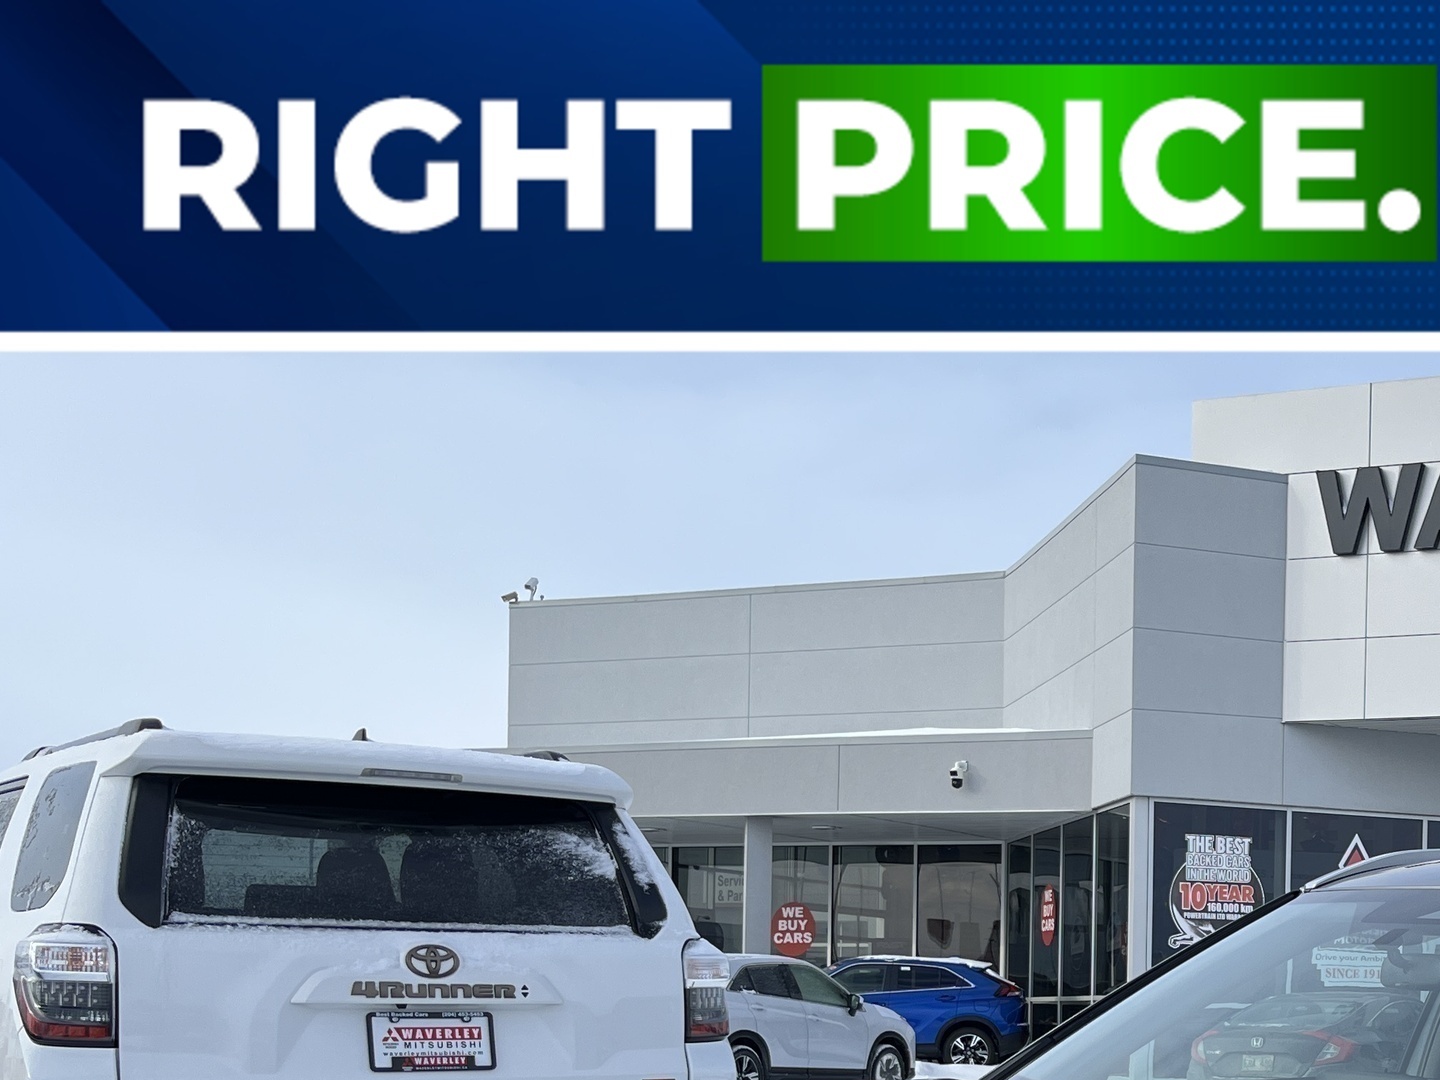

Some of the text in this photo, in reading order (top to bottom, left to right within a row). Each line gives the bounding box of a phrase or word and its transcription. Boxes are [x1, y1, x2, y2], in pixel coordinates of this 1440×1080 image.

[1186, 835, 1252, 855] THE BEST
[1187, 853, 1251, 868] BACKED CARS
[717, 875, 744, 887] Servi
[1187, 868, 1251, 882] IN THE WORLD
[718, 890, 744, 901] & Par
[1044, 890, 1052, 902] WE
[1180, 882, 1254, 911] 10 YEAR
[781, 907, 804, 918] WE
[1043, 904, 1054, 917] BUY
[1207, 903, 1253, 914] 160,000 km
[778, 919, 808, 931] BUY
[1041, 919, 1055, 931] CARS
[773, 932, 812, 944] CARS
[1315, 953, 1337, 961] Drive
[1325, 968, 1380, 979] SINCE 191
[400, 1028, 480, 1040] WAVERLEY
[404, 1041, 482, 1049] MITSUBISHI
[414, 1057, 466, 1065] WAVERLEY
